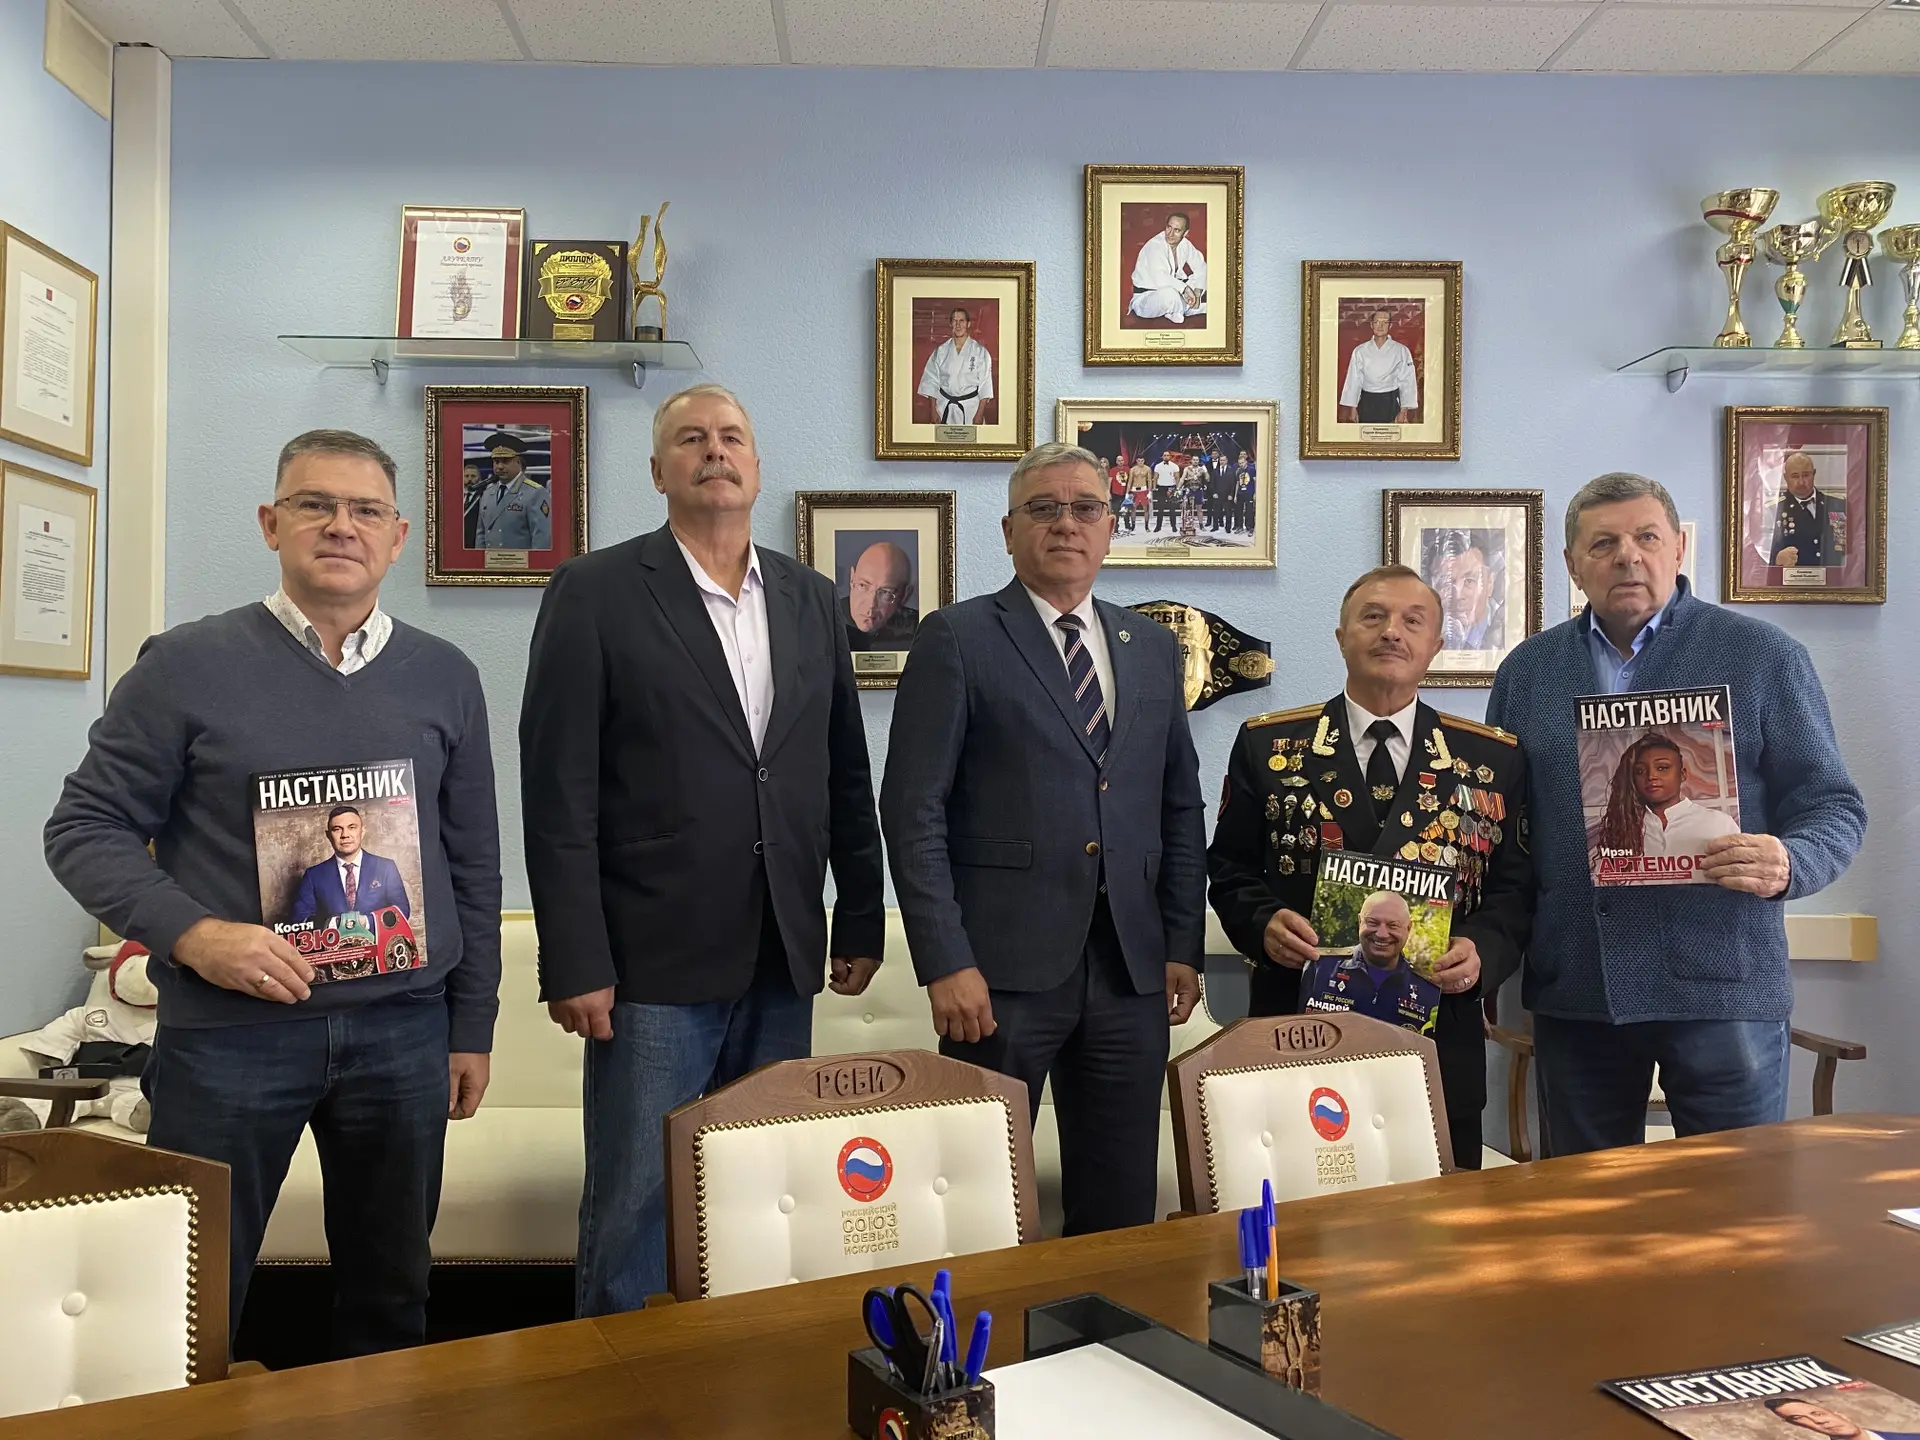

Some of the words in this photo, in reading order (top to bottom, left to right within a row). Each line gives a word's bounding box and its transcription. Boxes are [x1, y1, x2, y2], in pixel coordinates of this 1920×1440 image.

[560, 255, 594, 263] ДИПЛОМ
[1141, 611, 1186, 624] СБИ
[1580, 694, 1722, 730] НАСТАВНИК
[259, 768, 408, 810] НАСТАВНИК
[1601, 847, 1633, 858] Ирэн
[1323, 856, 1451, 900] НАСТАВНИК
[274, 921, 314, 934] Костя
[287, 927, 341, 952] ЗЮ
[1306, 997, 1350, 1012] Андрей
[1275, 1024, 1327, 1050] РСБИ
[816, 1065, 886, 1098] РСБИ
[1315, 1152, 1356, 1167] СОЮЗ
[1316, 1164, 1357, 1176] БОЕВЫХ
[1318, 1174, 1357, 1185] ИСКУССТВ
[840, 1201, 897, 1218] РОССИЙСКИЙ
[842, 1213, 898, 1233] СОЮЗ
[843, 1227, 899, 1245] БОЕВЫХ
[844, 1240, 899, 1256] ИСКУССТВ
[1622, 1360, 1854, 1410] НАСТАВНИК
